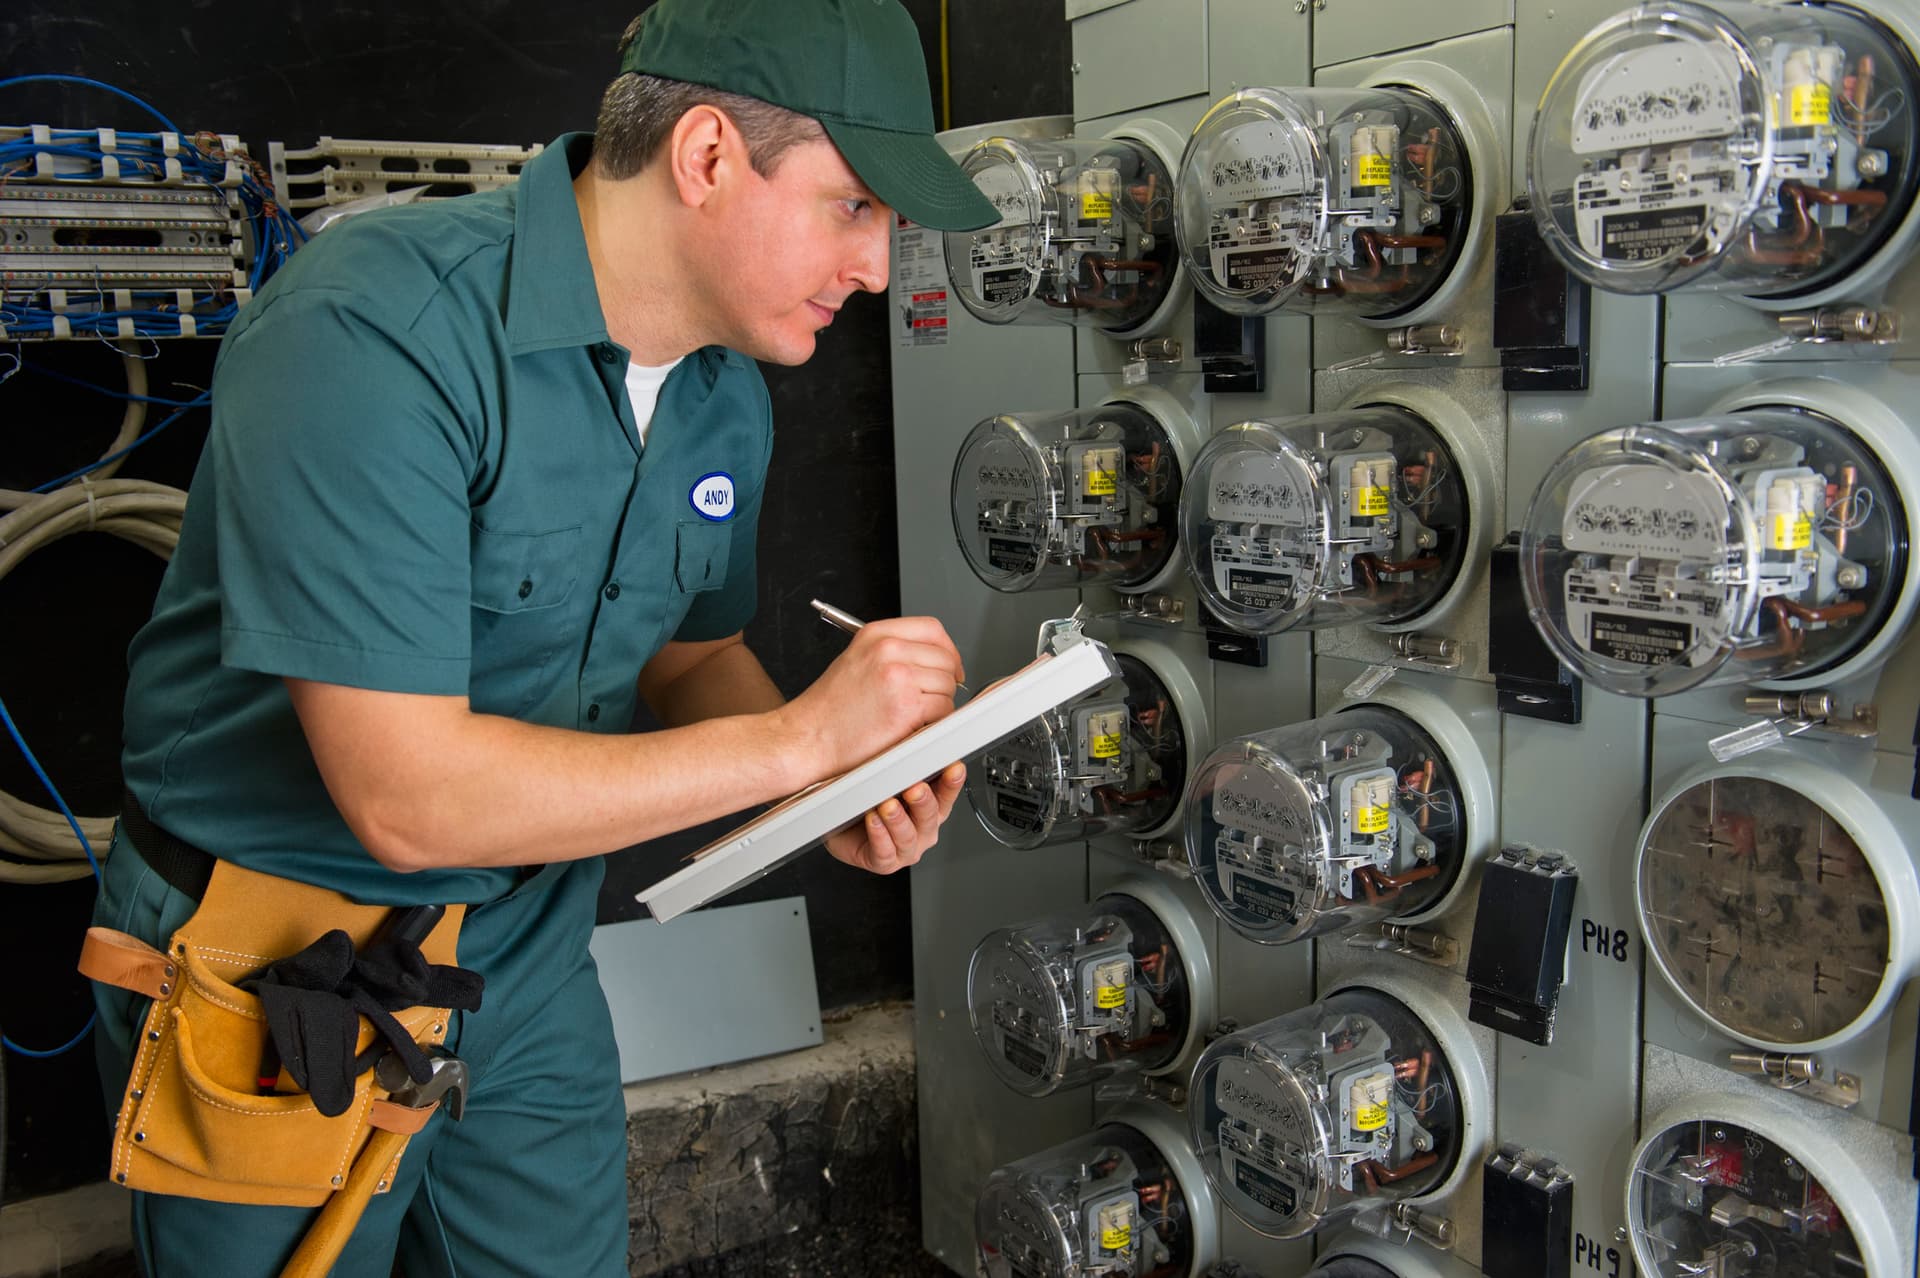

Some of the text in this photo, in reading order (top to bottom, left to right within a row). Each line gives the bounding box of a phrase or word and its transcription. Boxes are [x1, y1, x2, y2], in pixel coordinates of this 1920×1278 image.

[704, 489, 729, 506] ANDY
[1614, 649, 1627, 660] 25
[1582, 918, 1629, 962] PH8
[1575, 1232, 1621, 1278] PH9
